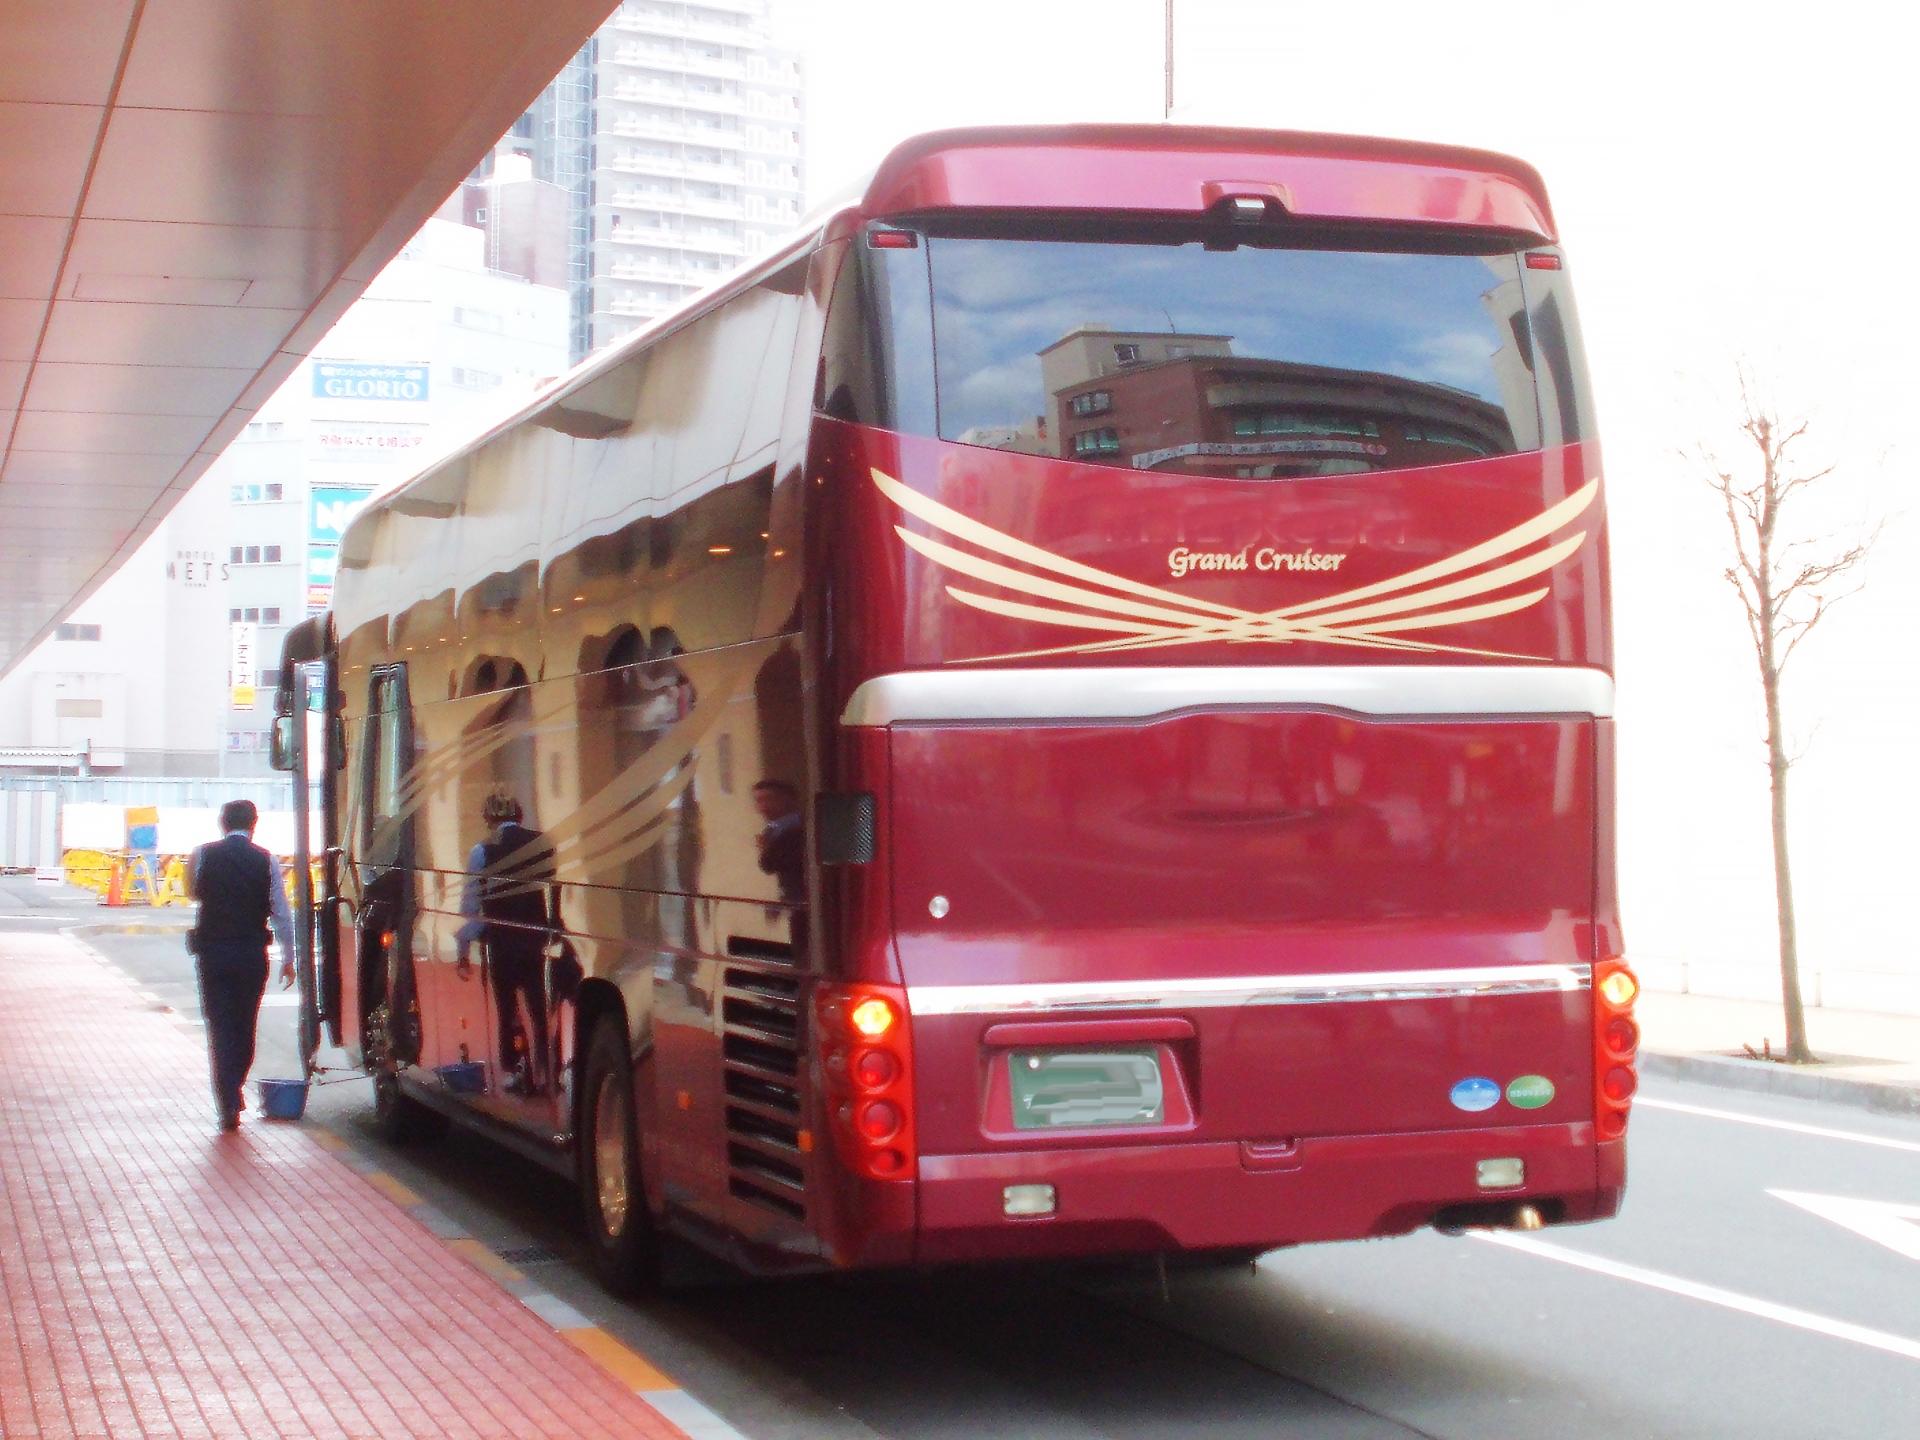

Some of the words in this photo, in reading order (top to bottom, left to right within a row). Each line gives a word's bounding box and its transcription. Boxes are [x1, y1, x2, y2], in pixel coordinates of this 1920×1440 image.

[325, 378, 420, 399] GLORIO
[1168, 546, 1254, 578] Grand
[1255, 548, 1347, 572] Cruiser
